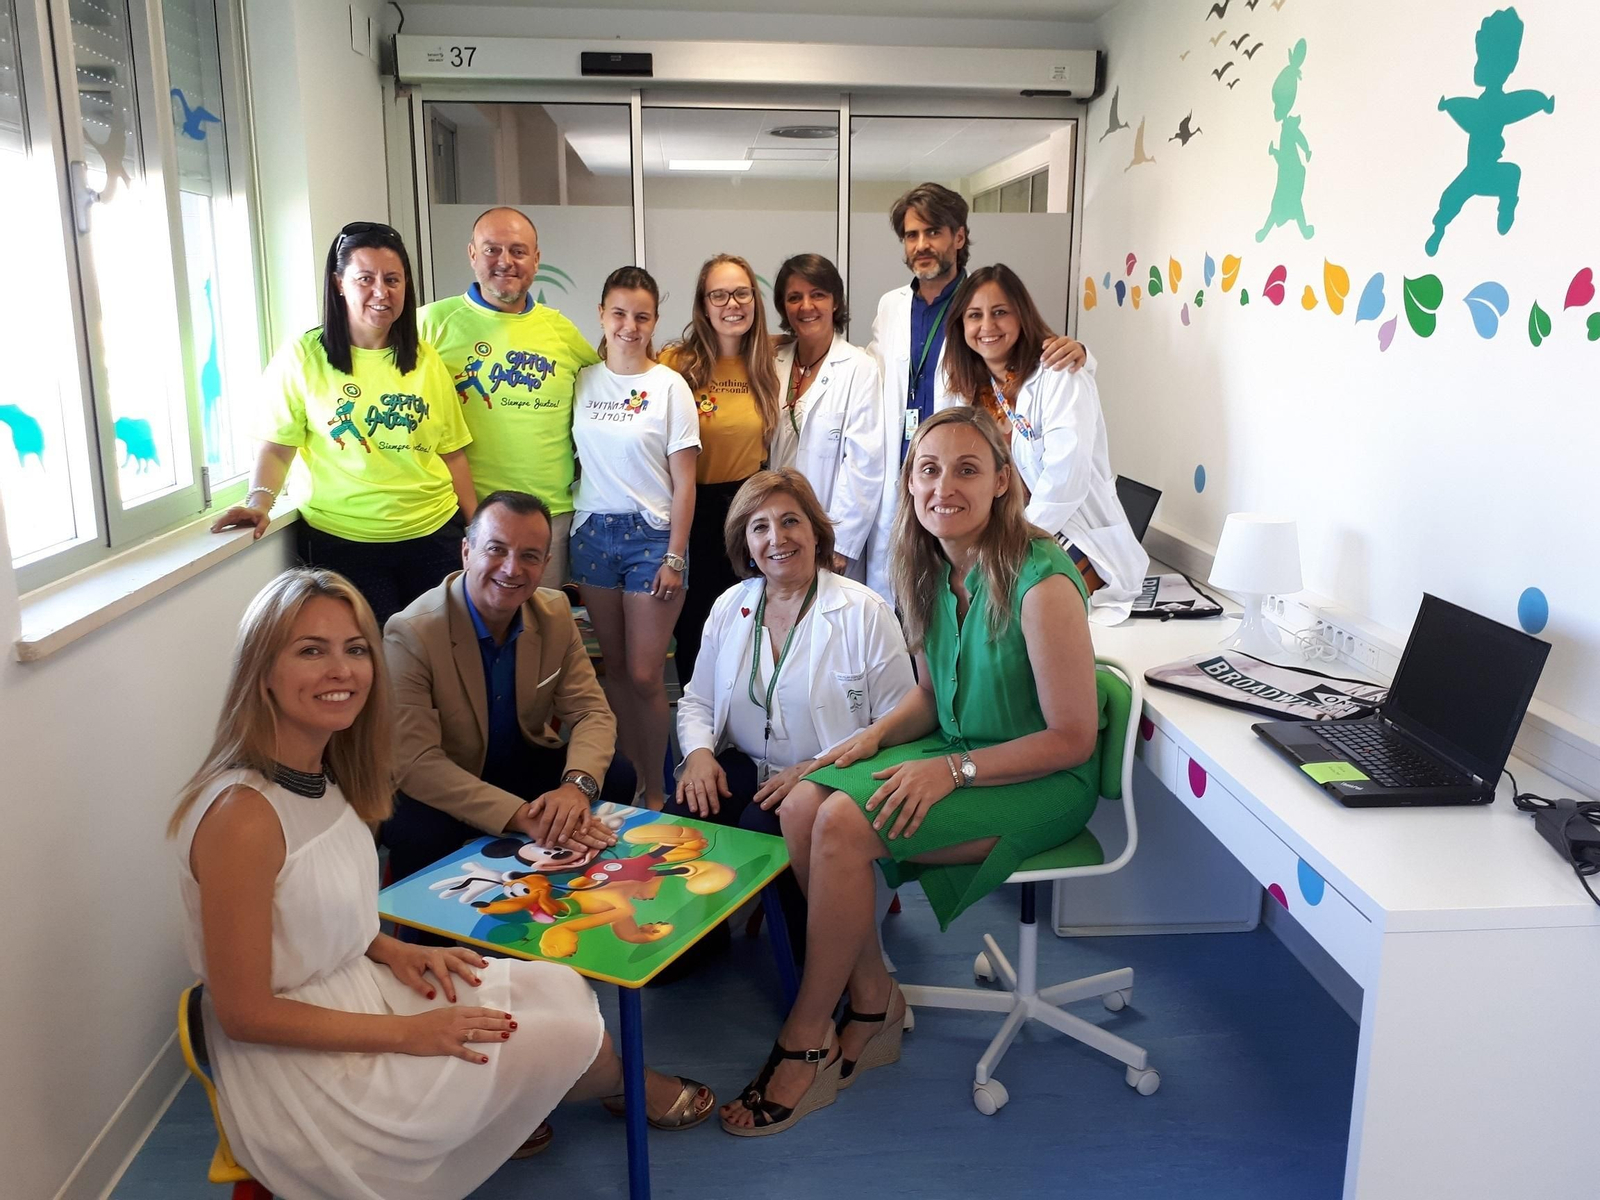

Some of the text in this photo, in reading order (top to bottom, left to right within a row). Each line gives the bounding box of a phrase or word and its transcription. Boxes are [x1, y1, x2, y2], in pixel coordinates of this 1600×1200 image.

[450, 46, 477, 67] 37
[708, 385, 749, 394] Personal
[711, 379, 748, 388] Nothing
[500, 397, 531, 409] Siempre
[378, 441, 411, 453] Siempre
